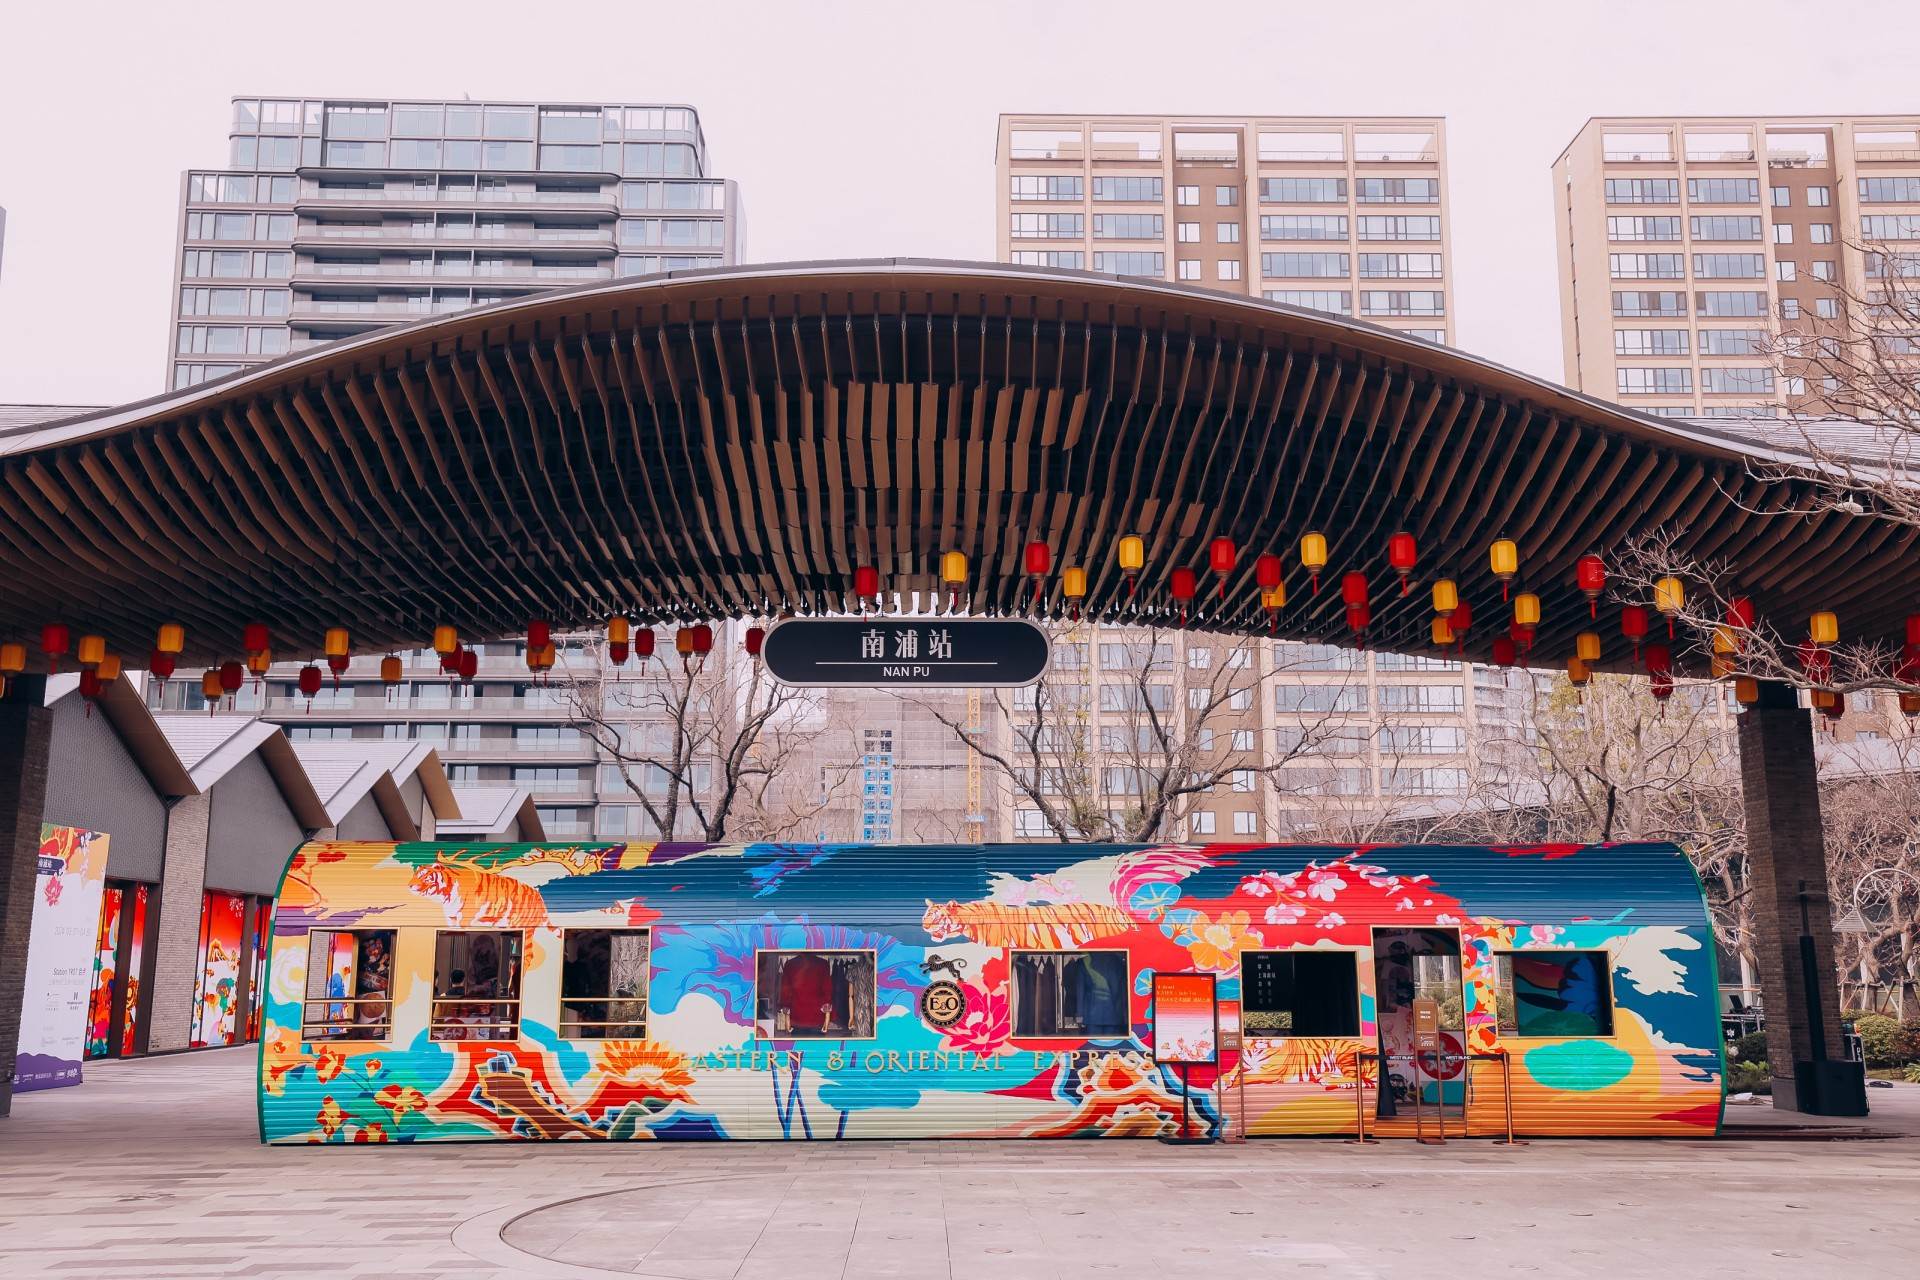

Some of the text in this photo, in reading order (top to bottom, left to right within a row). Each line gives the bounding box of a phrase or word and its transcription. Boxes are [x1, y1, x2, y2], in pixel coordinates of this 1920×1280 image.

[861, 628, 953, 659] 南浦站
[883, 666, 930, 677] NAN PU
[677, 1050, 1154, 1075] EASTERN & ORIENTAL EXPRESS
